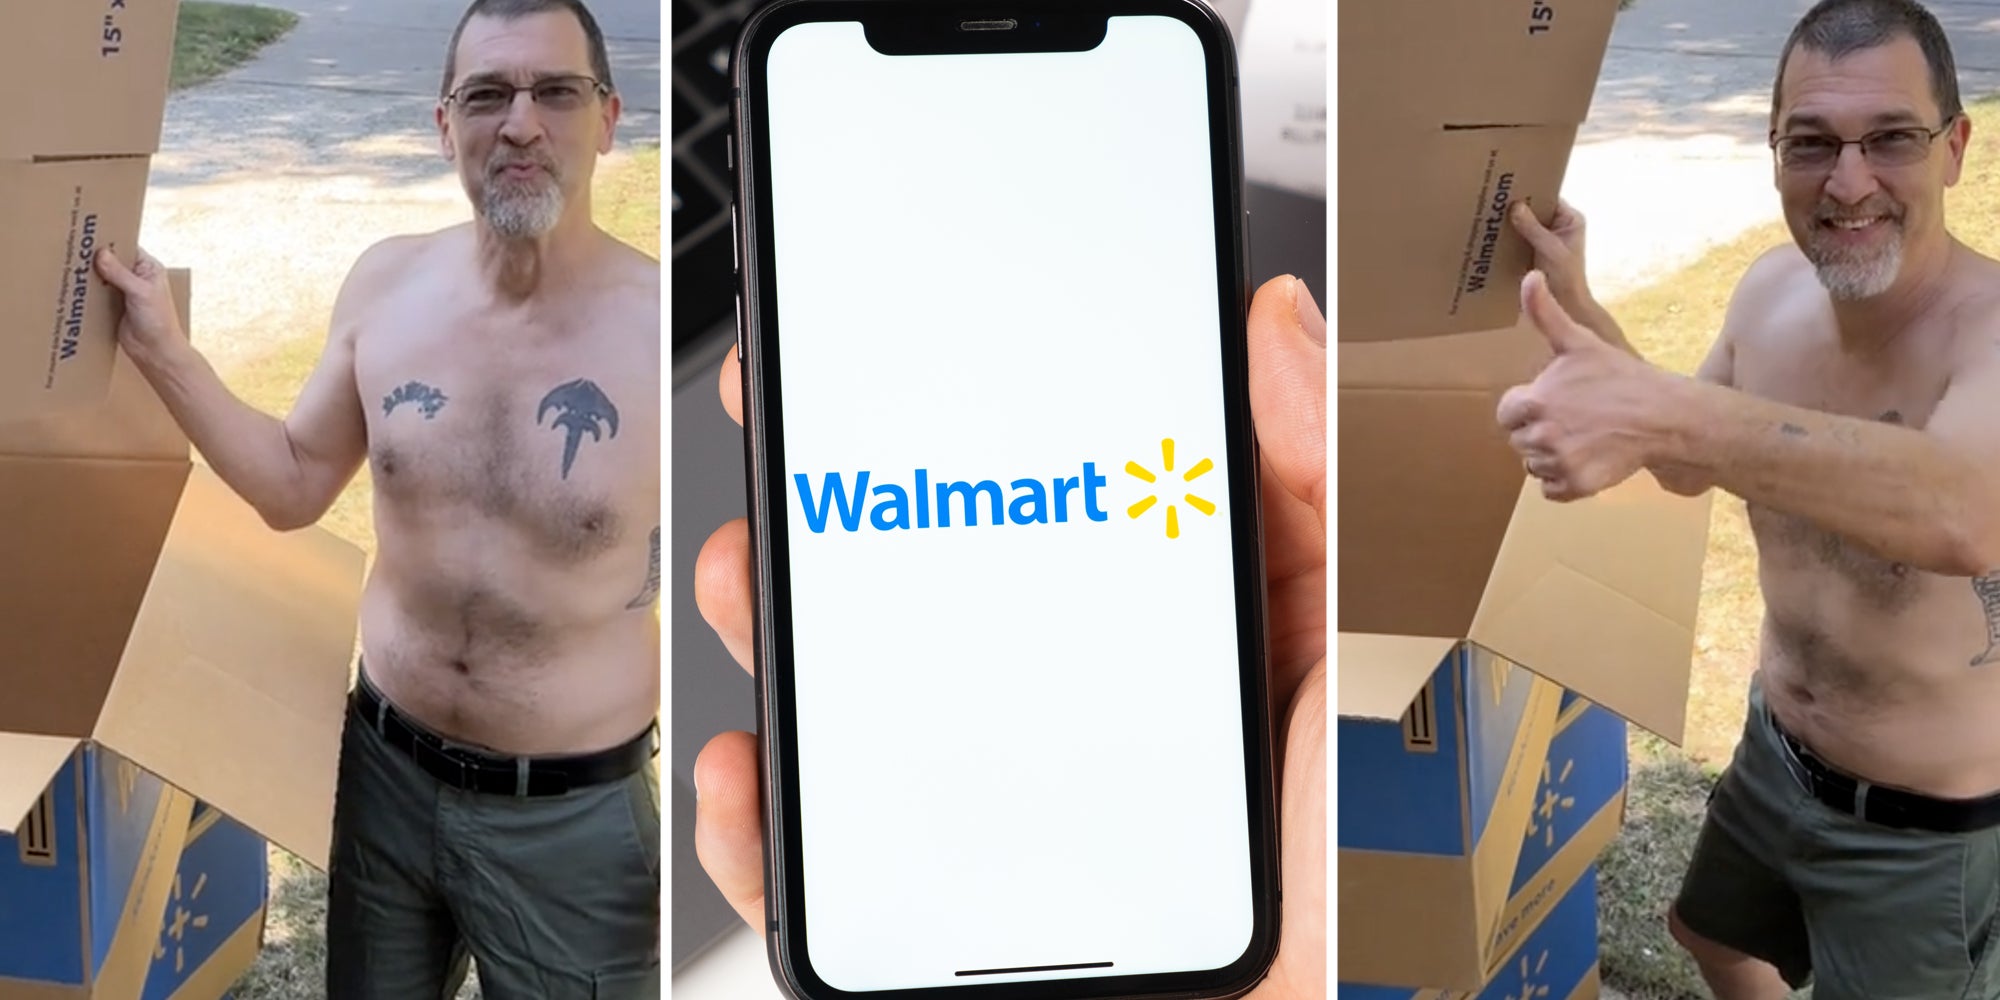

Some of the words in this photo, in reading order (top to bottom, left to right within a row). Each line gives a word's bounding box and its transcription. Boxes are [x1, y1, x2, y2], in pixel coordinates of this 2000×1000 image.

[103, 15, 121, 57] 15"
[1466, 171, 1514, 293] Walmart.com
[60, 214, 97, 360] Walmart.com
[793, 462, 1108, 534] Walmart
